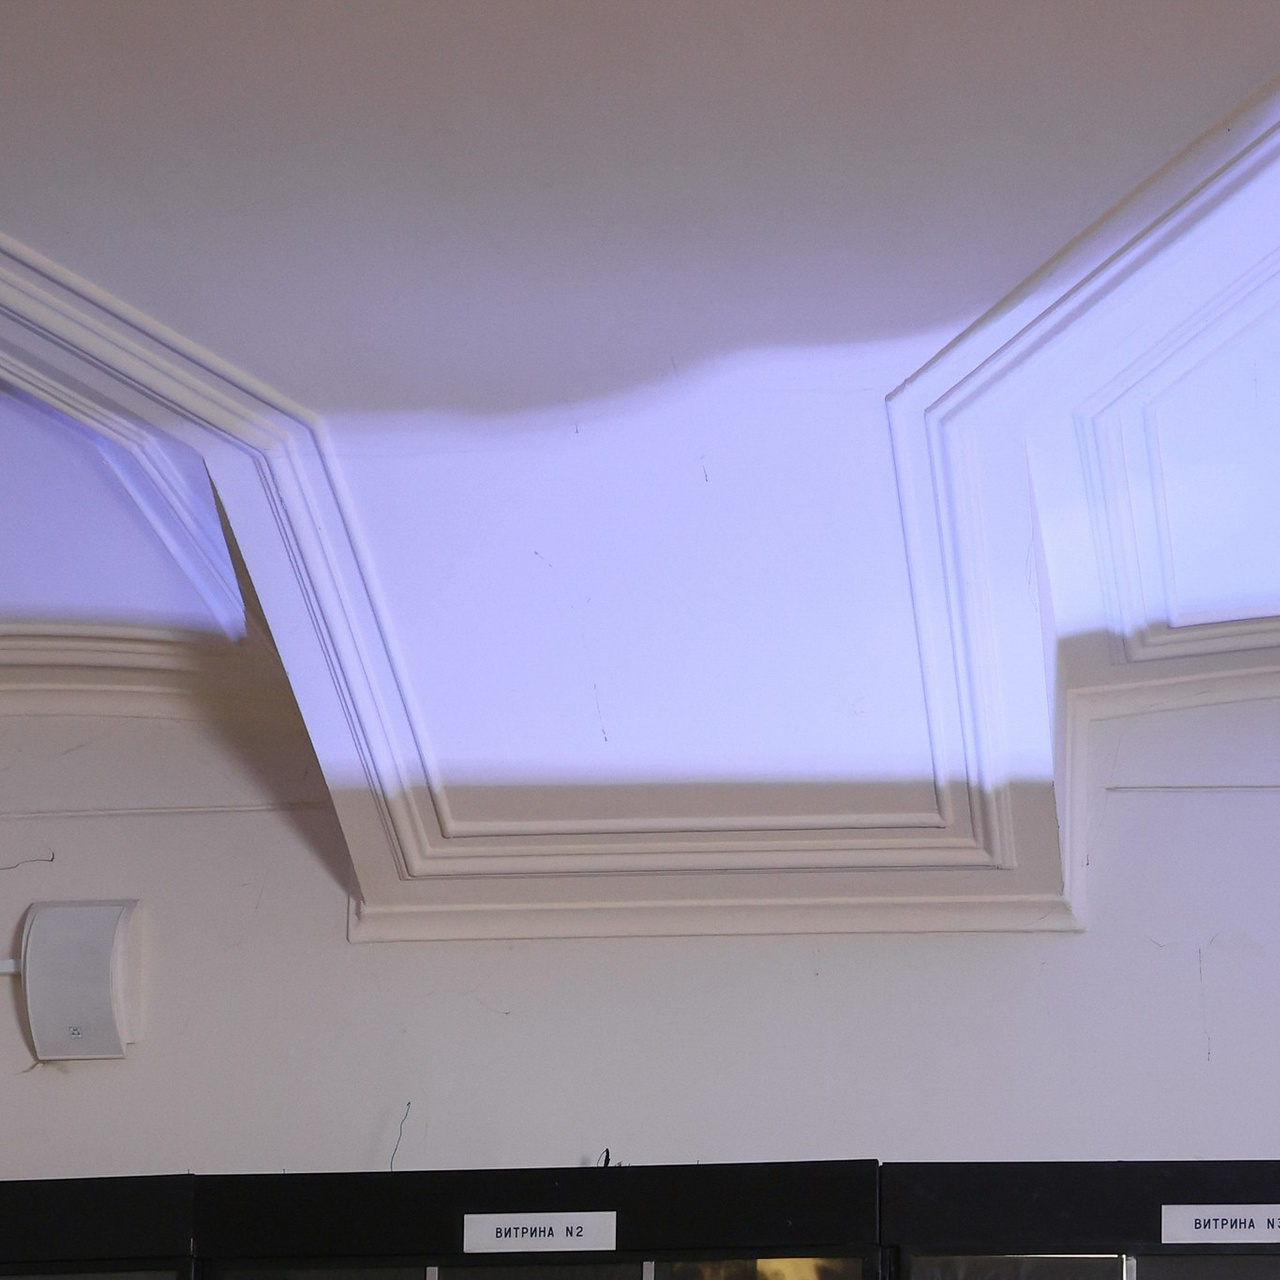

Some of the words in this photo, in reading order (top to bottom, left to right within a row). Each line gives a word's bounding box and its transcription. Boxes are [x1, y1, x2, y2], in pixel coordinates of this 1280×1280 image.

[1194, 1218, 1256, 1230] ВИТРИНА
[495, 1226, 555, 1239] ВИТРИНА
[565, 1225, 584, 1238] N2
